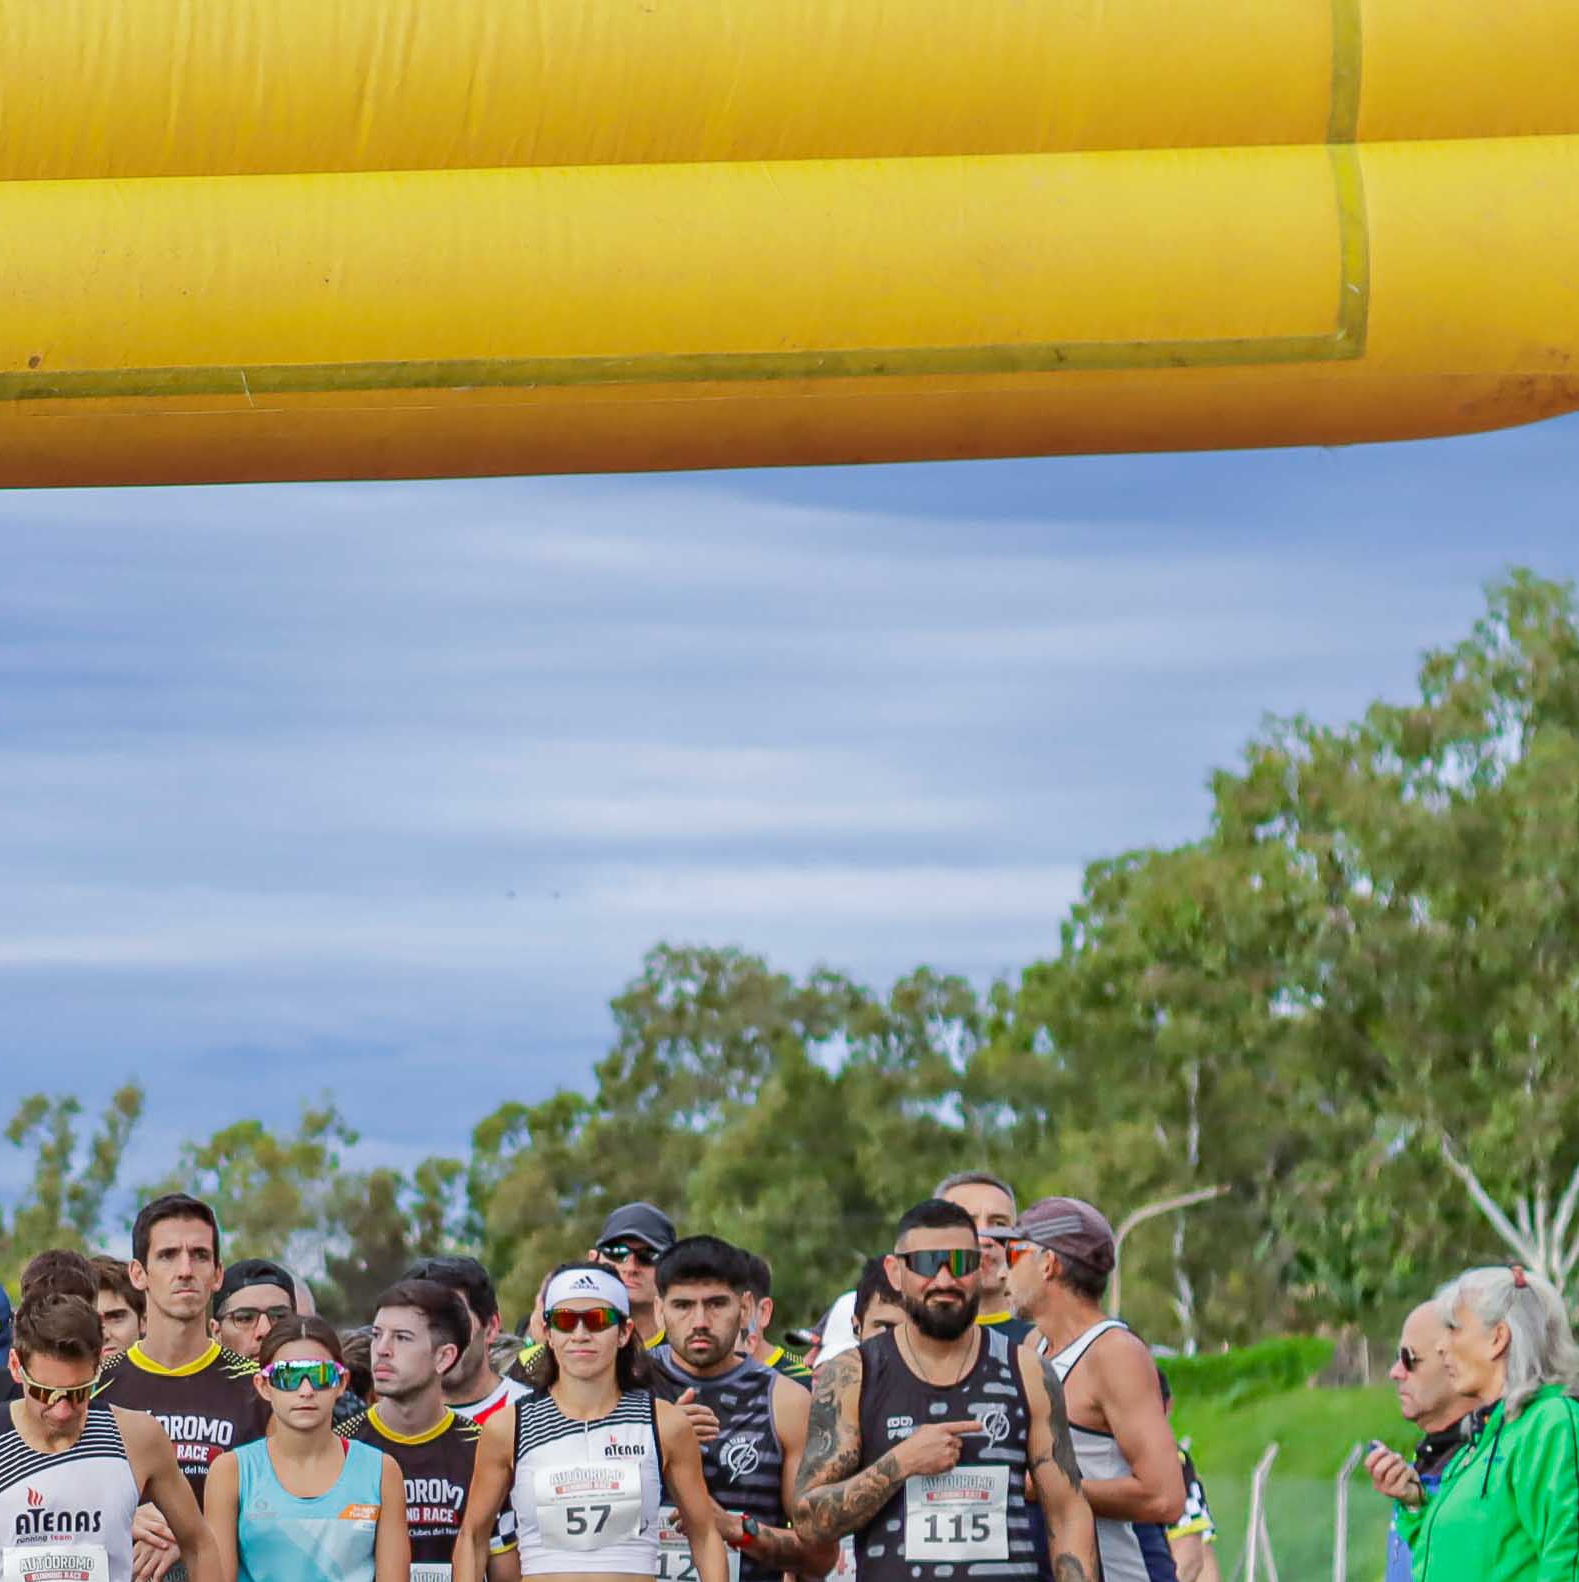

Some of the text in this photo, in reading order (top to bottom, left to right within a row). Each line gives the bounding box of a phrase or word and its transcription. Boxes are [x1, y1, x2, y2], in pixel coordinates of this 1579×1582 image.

[177, 1443, 210, 1461] RACE
[604, 1444, 645, 1456] ATENAS
[16, 1508, 102, 1536] ATENAS
[423, 1507, 454, 1523] RACE
[566, 1504, 611, 1536] 57
[924, 1513, 991, 1543] 115
[16, 1534, 48, 1544] running
[20, 1552, 95, 1574] AUTÓDROMO
